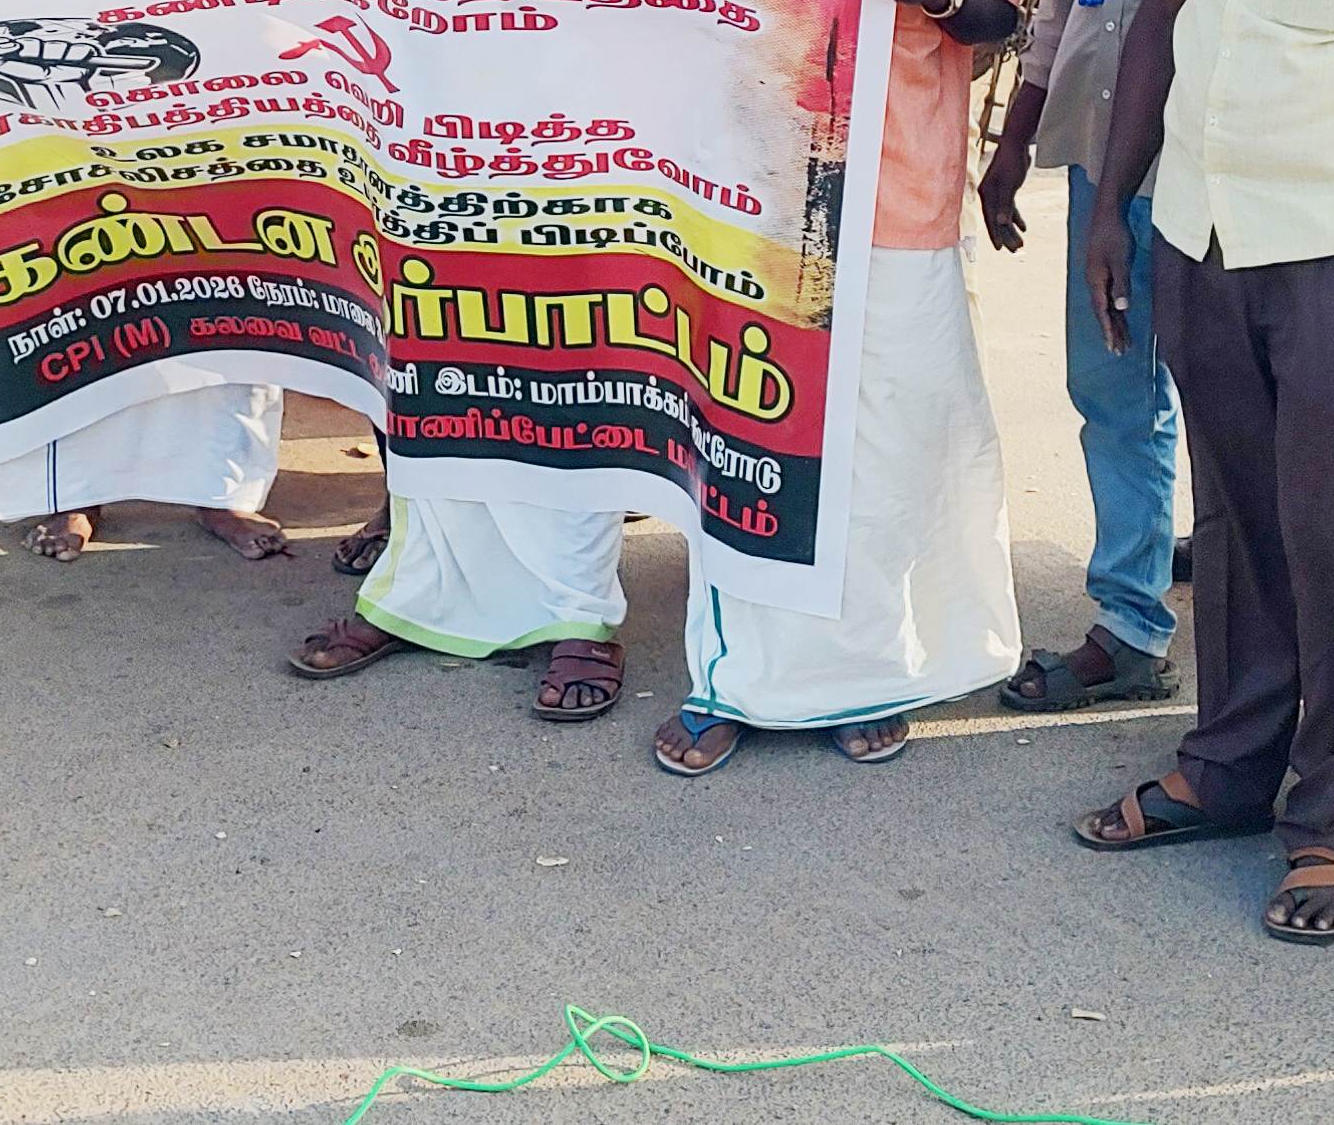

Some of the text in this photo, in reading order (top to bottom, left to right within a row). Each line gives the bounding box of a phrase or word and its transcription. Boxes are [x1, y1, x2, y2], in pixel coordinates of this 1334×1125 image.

[85, 68, 636, 145] கொலை வெறி பிடித்த
[90, 132, 673, 221] உலக சமாதானத்திற்காக
[387, 138, 762, 216] வீழ்த்துவோம்
[521, 221, 765, 300] பிடிப்போம்
[9, 310, 87, 365] நாள்:
[90, 276, 245, 319] 07.01.2026
[247, 276, 321, 313] நேரம்:
[322, 292, 376, 337] மாலை
[434, 365, 523, 401] இடம்:
[40, 333, 106, 383] CPI
[114, 316, 172, 362] (M)
[189, 313, 303, 343] கலவை
